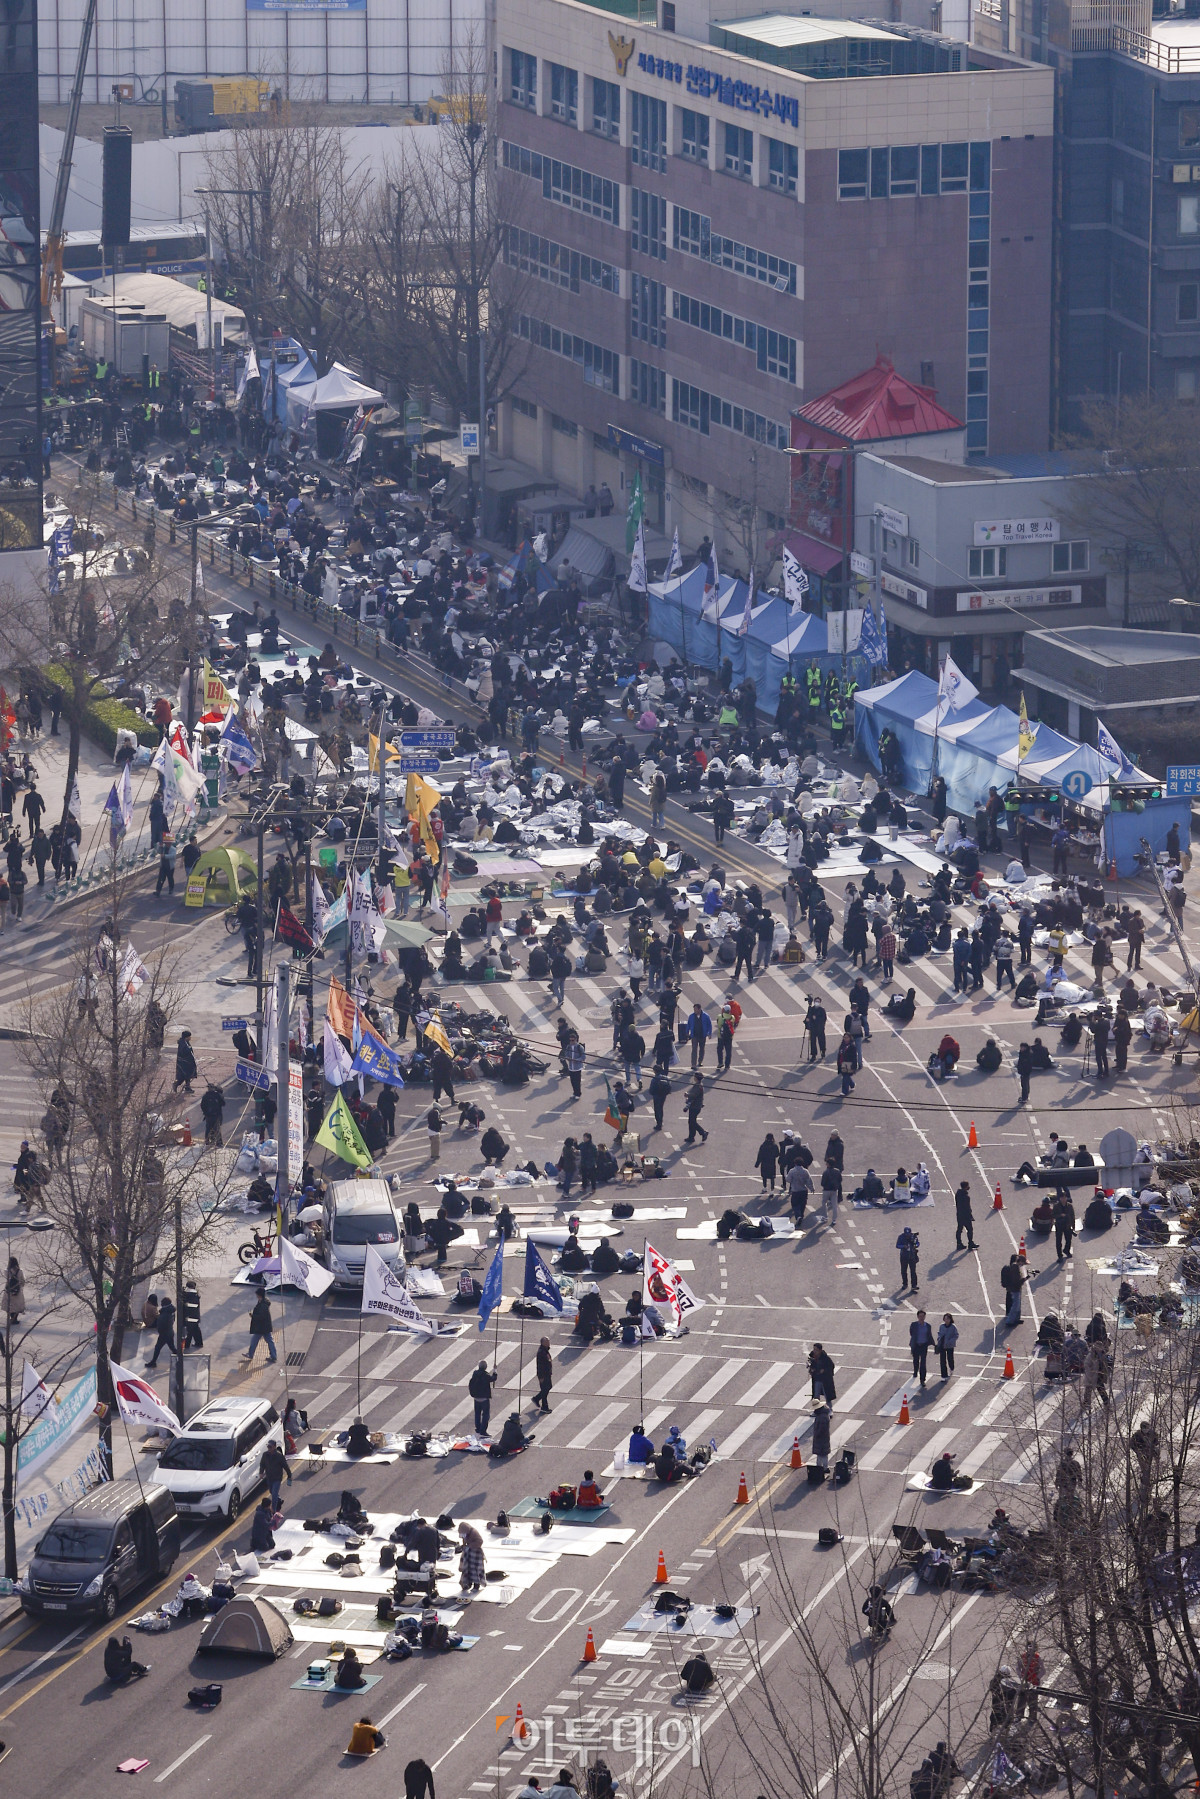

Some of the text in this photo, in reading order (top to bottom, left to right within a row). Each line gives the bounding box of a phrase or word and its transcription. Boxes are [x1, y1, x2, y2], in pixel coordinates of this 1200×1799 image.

[637, 52, 799, 128] 서울경찰청 산업기술안보수사대
[157, 265, 183, 273] POLICE
